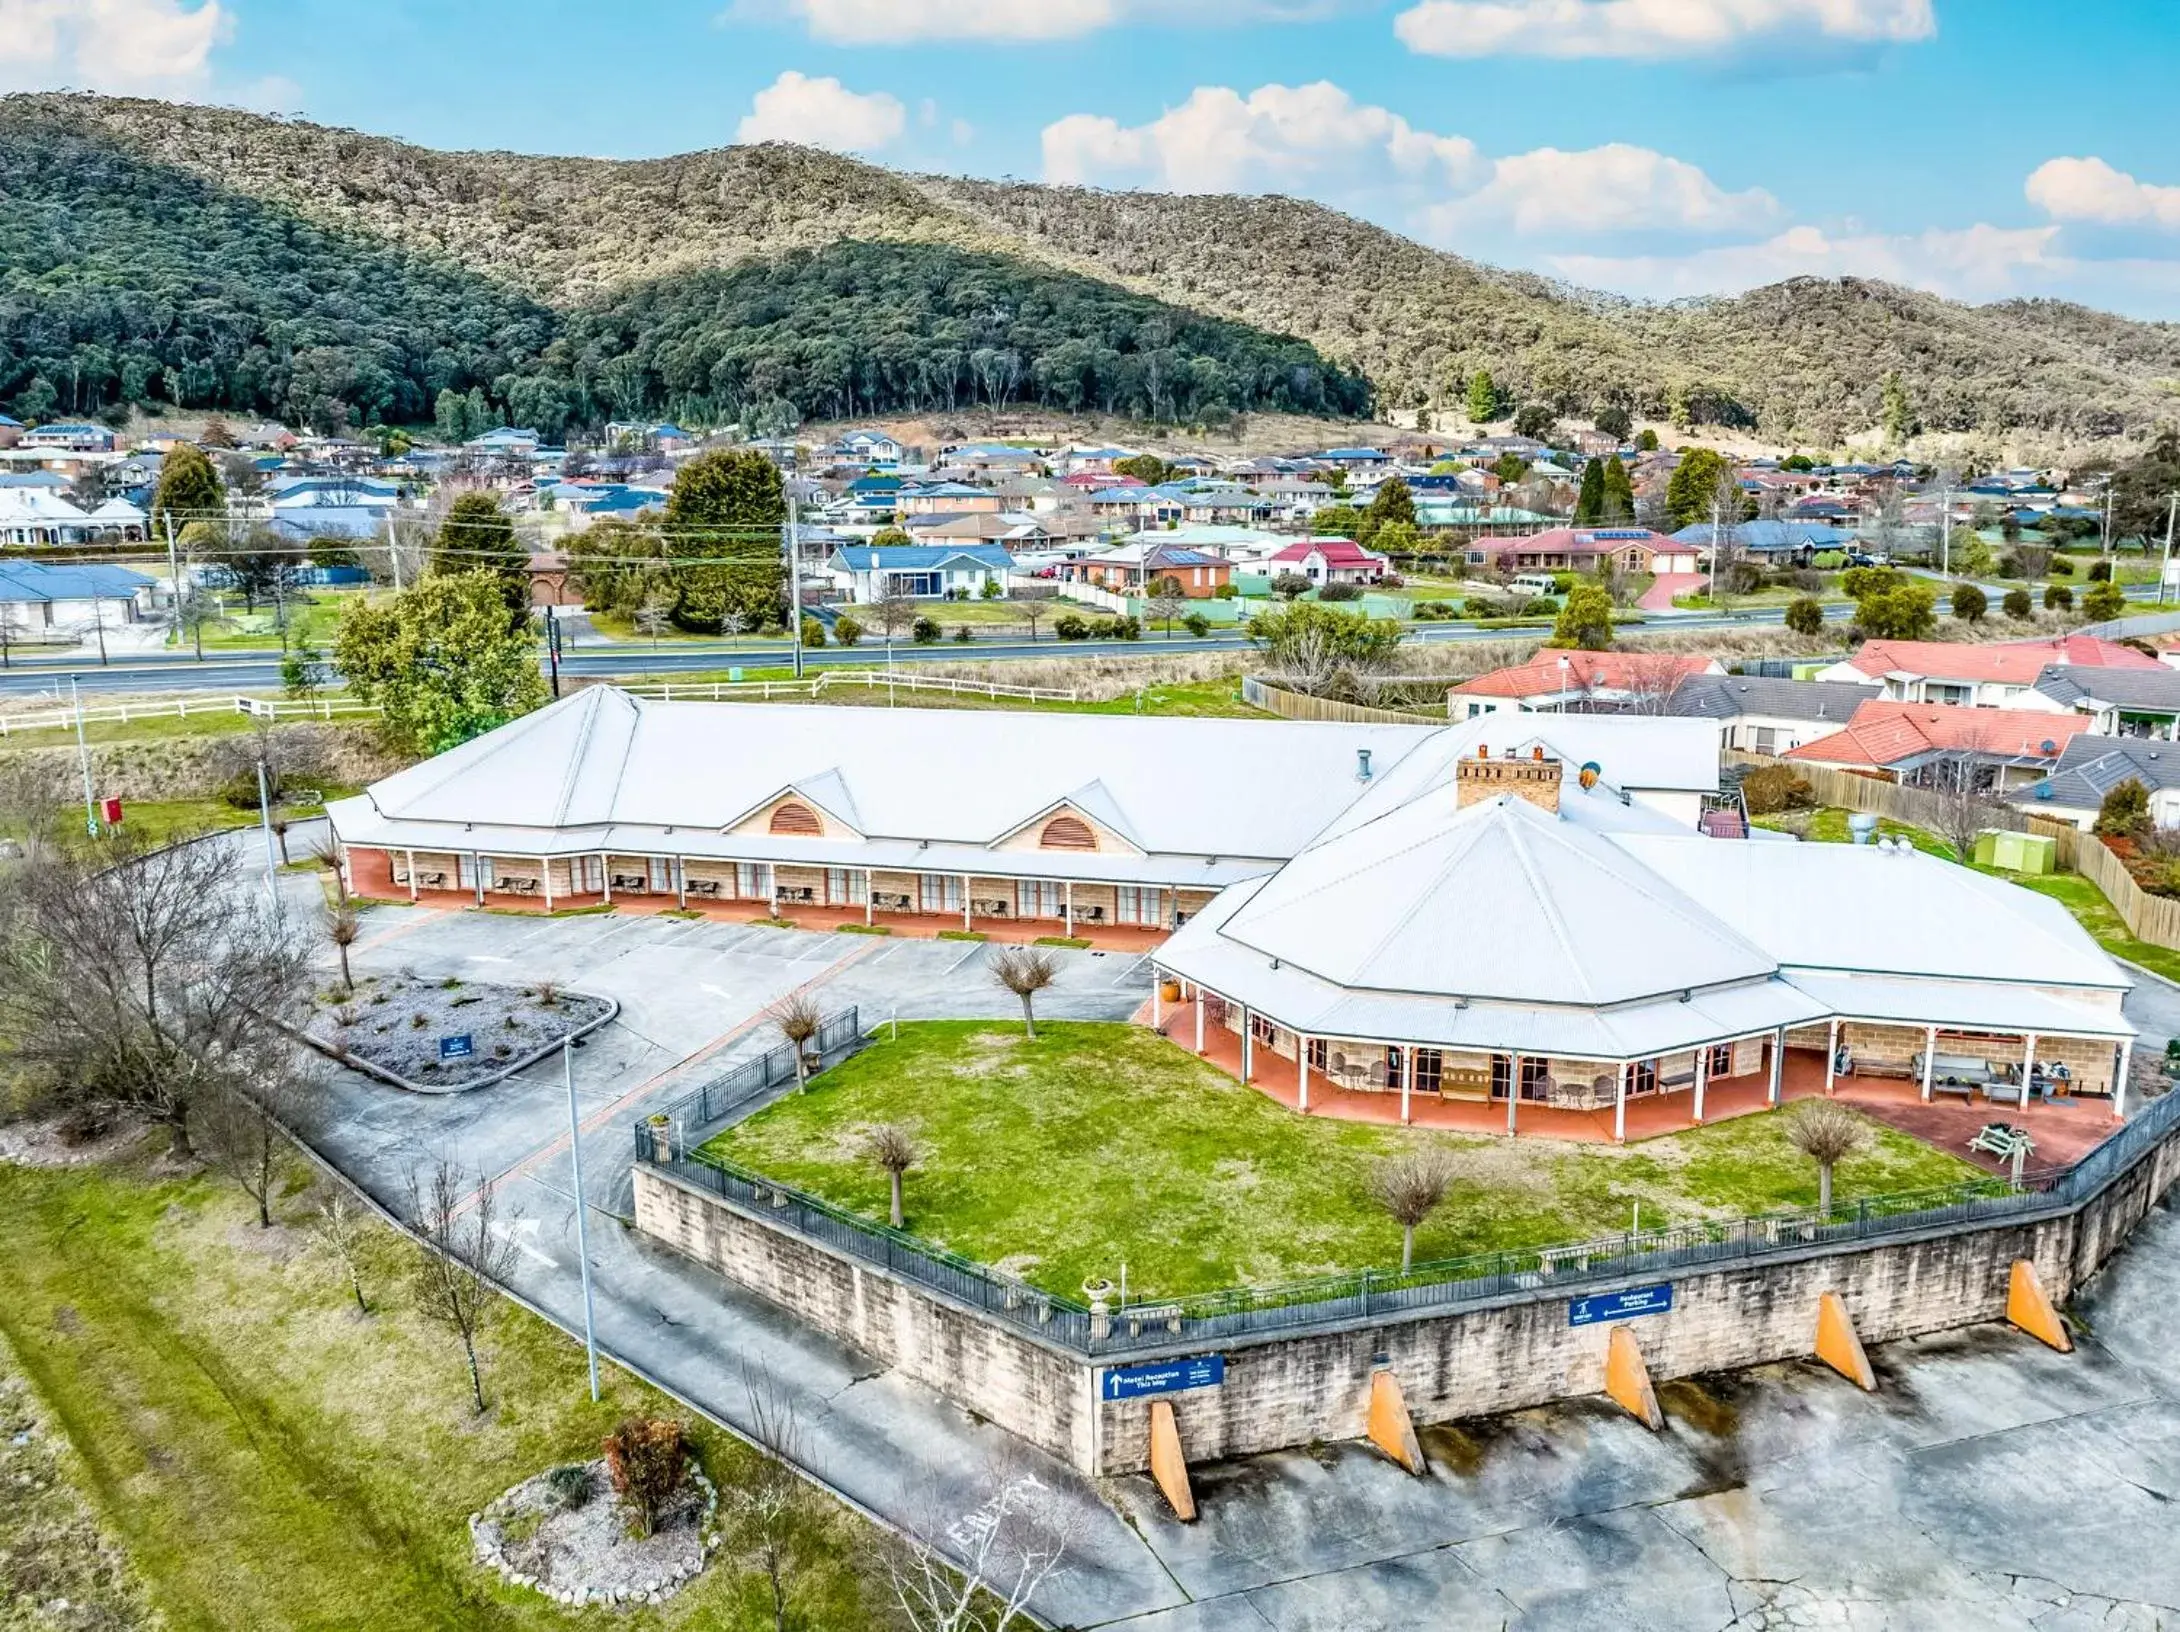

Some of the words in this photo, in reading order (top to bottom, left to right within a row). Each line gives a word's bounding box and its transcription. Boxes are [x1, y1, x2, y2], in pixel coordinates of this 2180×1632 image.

[1619, 1291, 1654, 1301] Restaurant
[1624, 1299, 1648, 1308] Parking
[1123, 1376, 1144, 1384] Motel
[1145, 1371, 1180, 1380] Reception
[1137, 1380, 1151, 1388] This
[1152, 1379, 1166, 1387] Way
